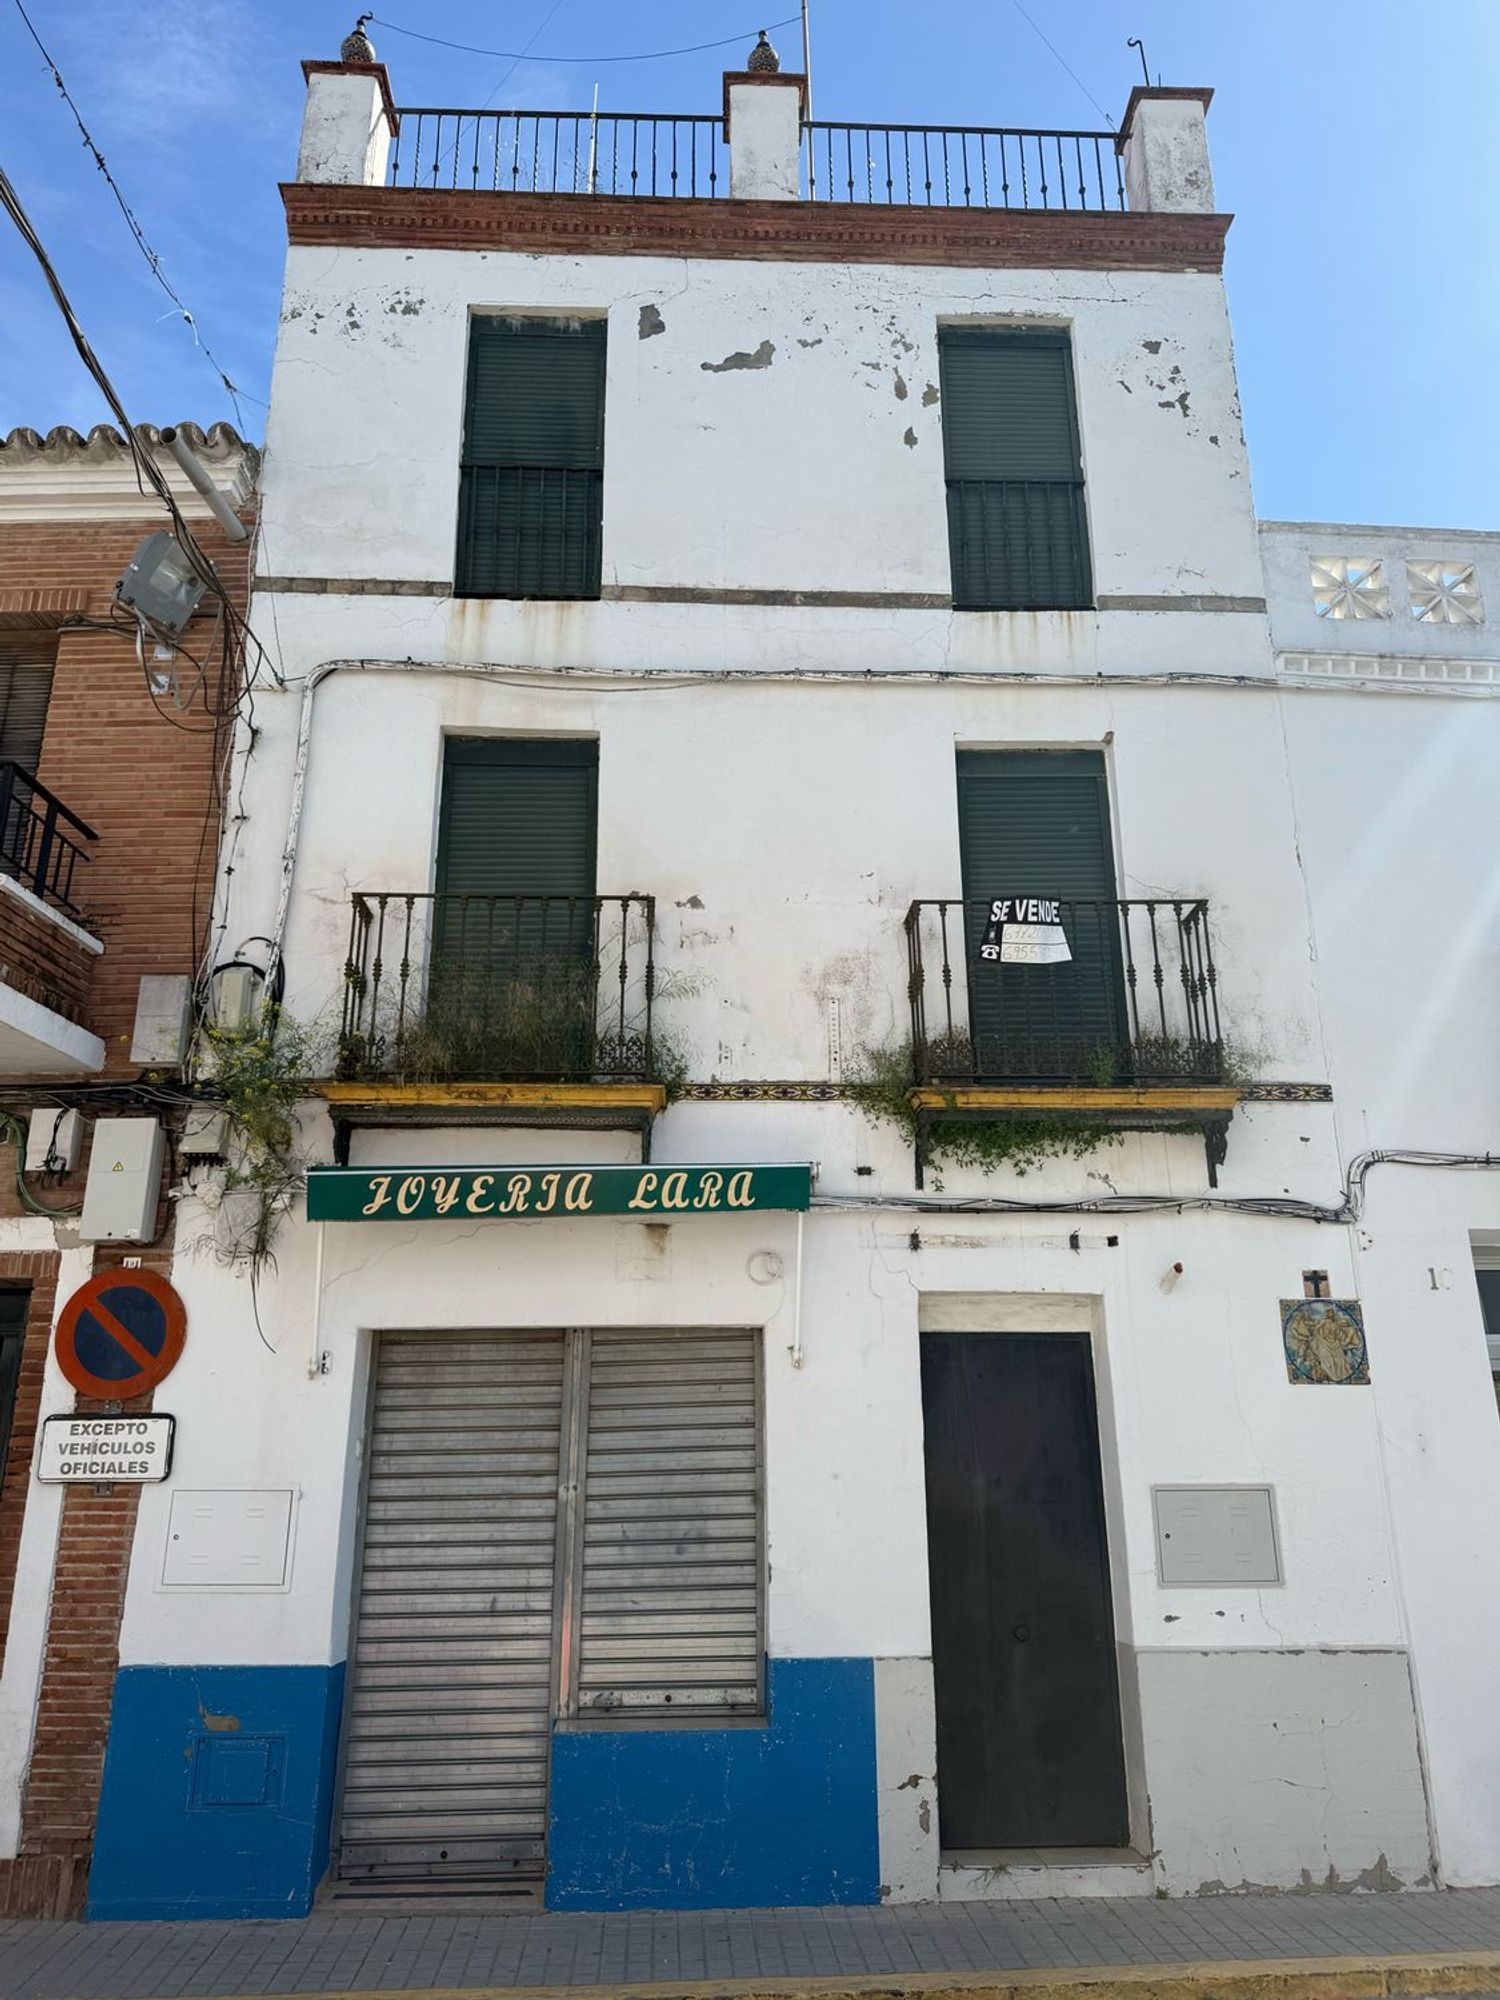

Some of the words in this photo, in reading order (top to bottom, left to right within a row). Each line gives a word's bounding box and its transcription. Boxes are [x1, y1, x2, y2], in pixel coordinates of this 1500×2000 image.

[990, 900, 1012, 922] SE
[1015, 899, 1061, 923] VENDE
[362, 1173, 594, 1216] JOYERIA
[627, 1171, 756, 1211] LARA
[69, 1422, 148, 1436] EXCEPTO
[58, 1438, 156, 1456] VEHÍCULOS
[60, 1461, 149, 1475] OFICIALES
